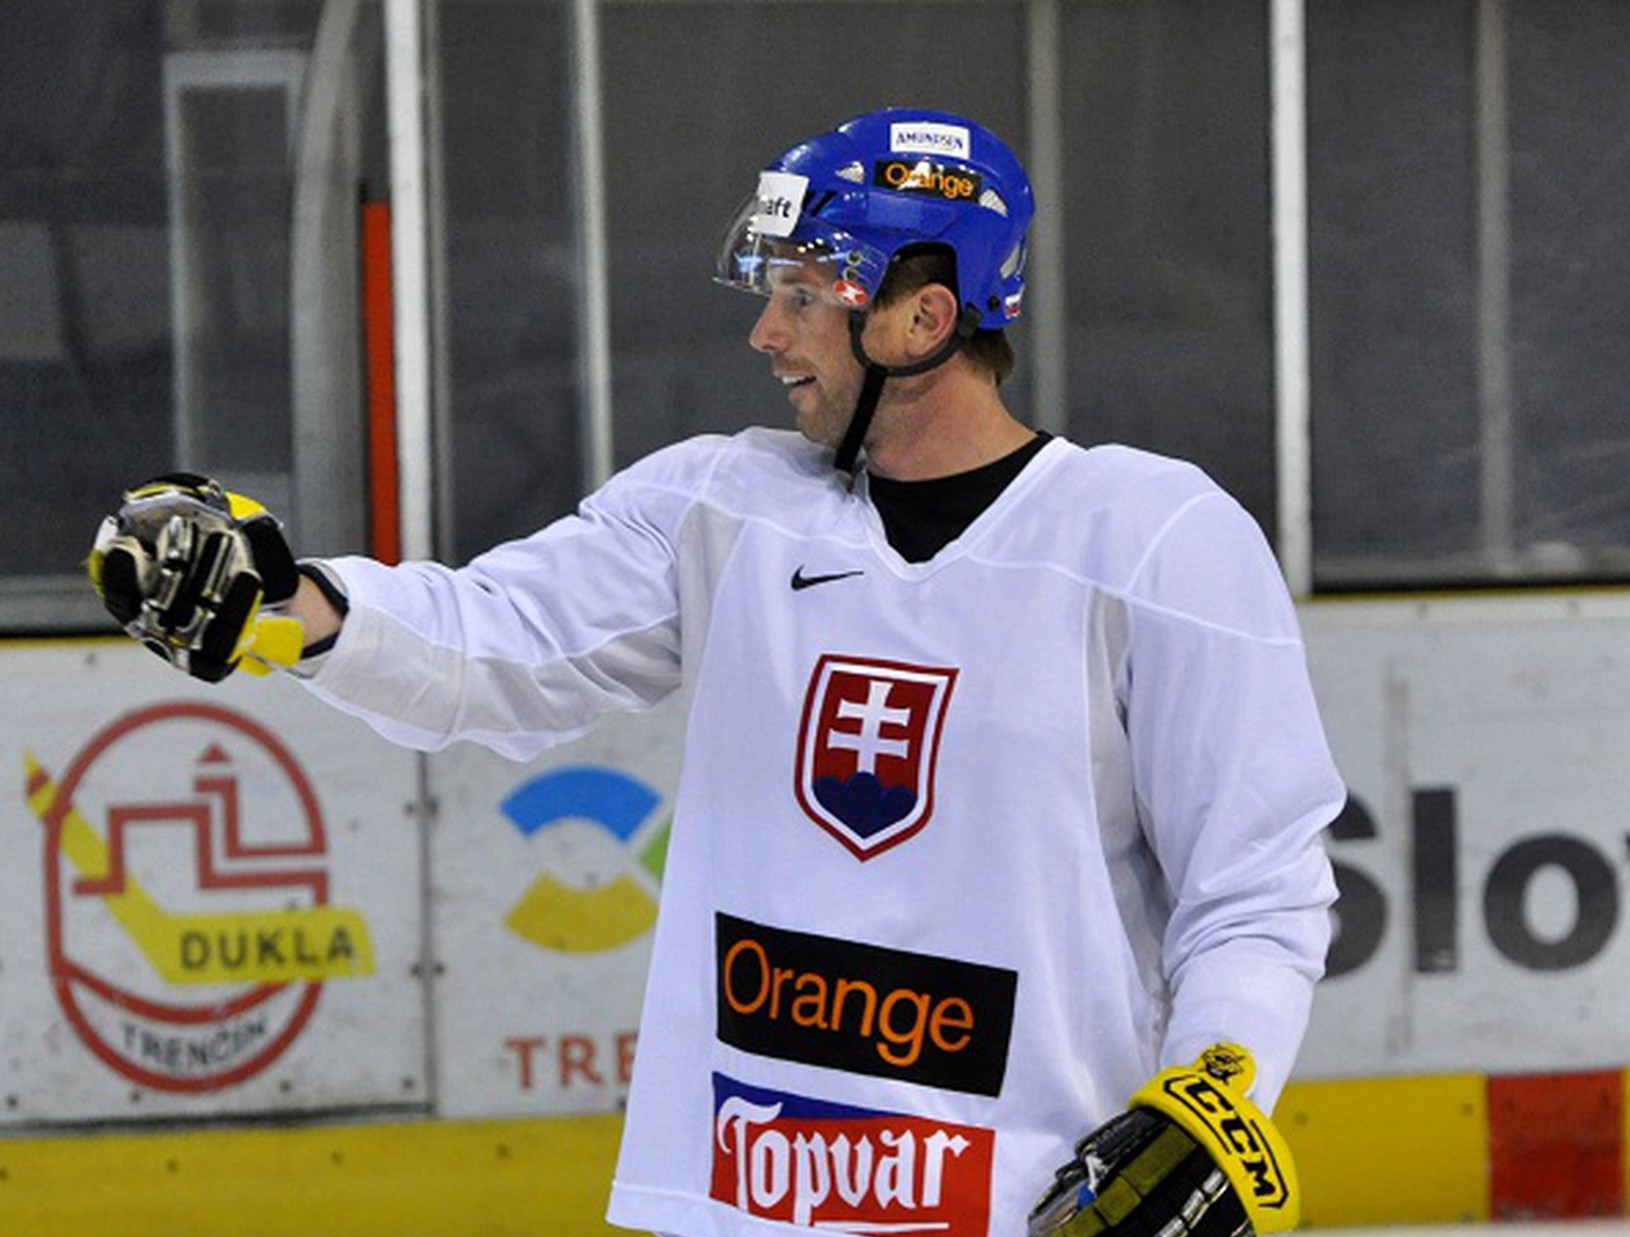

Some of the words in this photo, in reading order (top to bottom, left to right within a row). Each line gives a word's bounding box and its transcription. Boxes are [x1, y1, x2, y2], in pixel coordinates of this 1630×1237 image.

[885, 162, 974, 199] Orange
[1320, 785, 1630, 982] Slo
[180, 926, 355, 971] DUKLA
[723, 938, 976, 1068] Orange
[716, 1094, 972, 1227] Topvar
[1184, 1078, 1277, 1198] CCM
